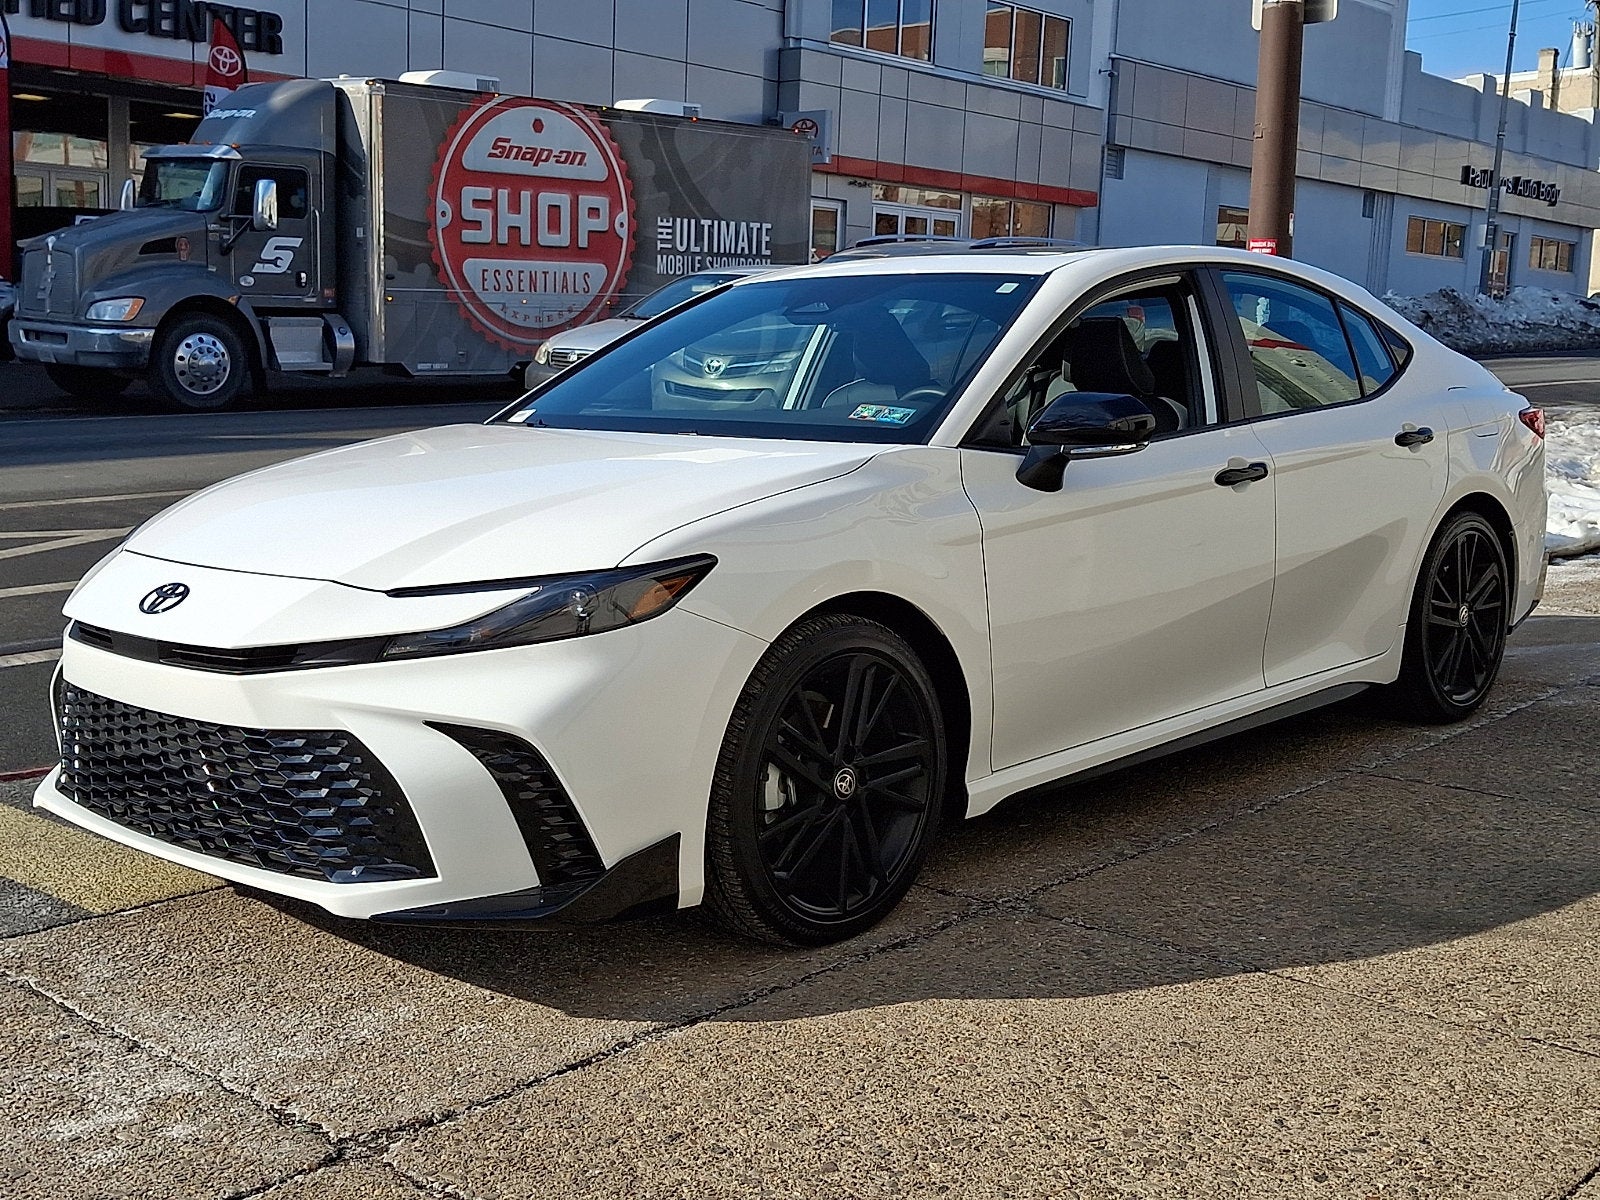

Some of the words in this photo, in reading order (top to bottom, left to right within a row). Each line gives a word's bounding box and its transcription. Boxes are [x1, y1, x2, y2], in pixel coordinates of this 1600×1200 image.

[487, 137, 587, 167] Snap-on
[1464, 166, 1493, 189] Paul
[1516, 178, 1538, 198] Auto
[1539, 181, 1561, 206] Body
[461, 186, 609, 248] SHOP
[657, 216, 673, 251] THE
[675, 217, 772, 256] ULTIMATE
[481, 268, 591, 294] ESSENTIALS
[657, 255, 702, 275] MOBILE
